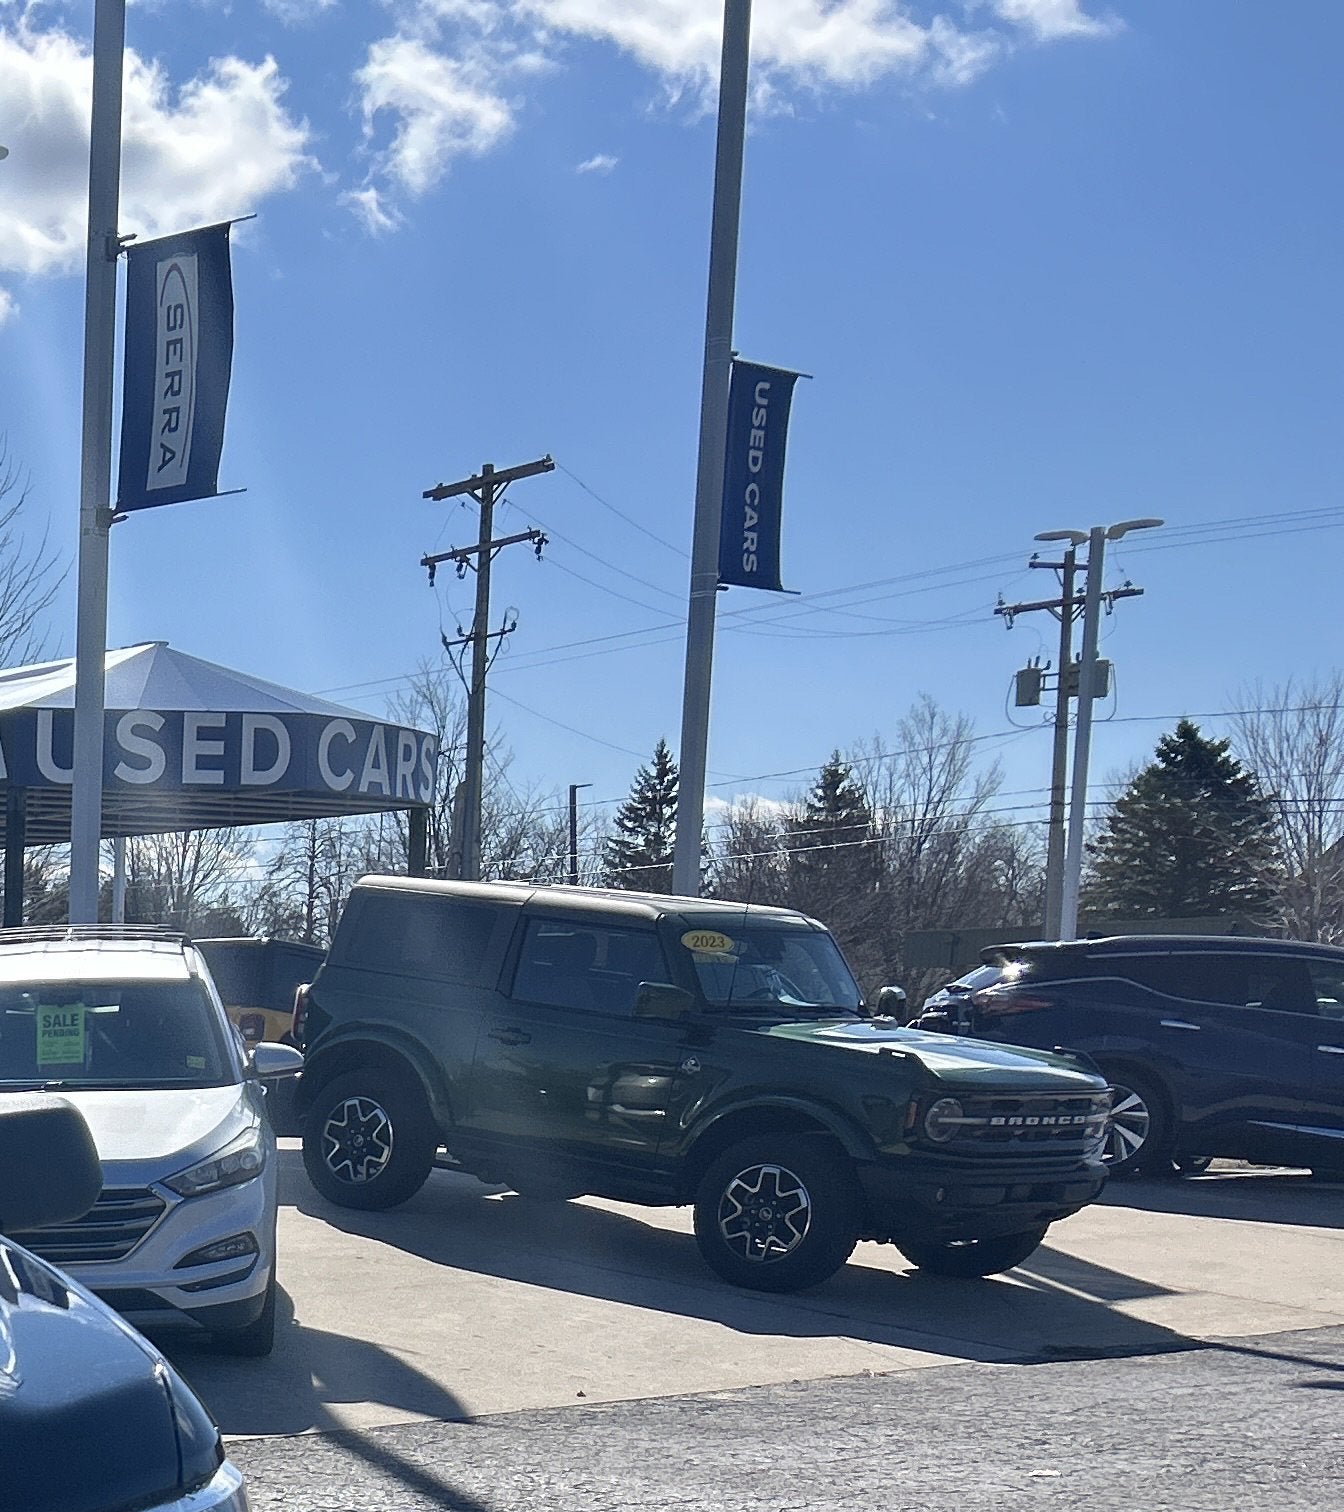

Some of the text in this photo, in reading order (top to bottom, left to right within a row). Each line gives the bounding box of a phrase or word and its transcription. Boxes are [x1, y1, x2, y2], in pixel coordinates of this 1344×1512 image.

[157, 303, 184, 473] SERRA
[742, 381, 771, 573] USED CARS
[36, 709, 292, 786] USED
[318, 718, 436, 805] CARS
[692, 935, 726, 948] 2023
[42, 1013, 79, 1028] SALE
[41, 1028, 80, 1038] PENDING
[990, 1115, 1087, 1126] BRONCO
